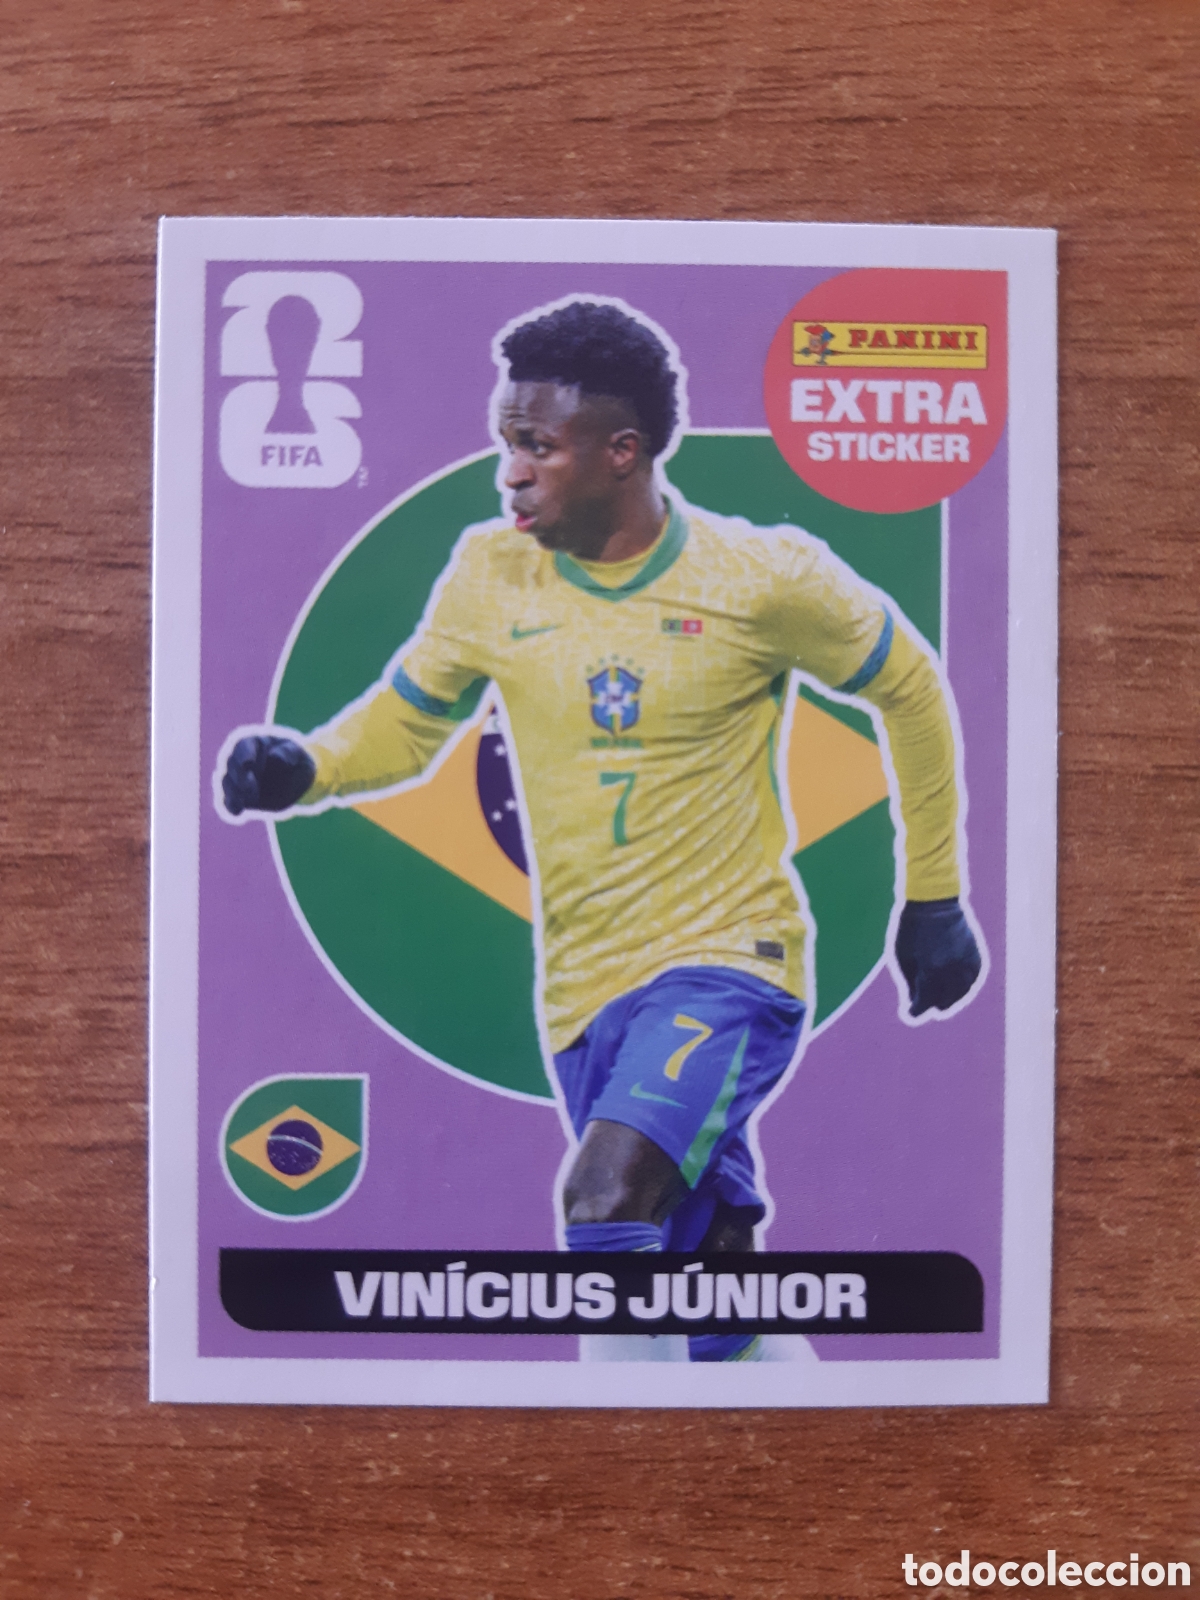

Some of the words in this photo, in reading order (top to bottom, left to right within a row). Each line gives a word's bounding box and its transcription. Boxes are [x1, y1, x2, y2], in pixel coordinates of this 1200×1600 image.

[849, 329, 978, 351] PANINI
[791, 378, 988, 425] EXTRA
[261, 445, 323, 467] FIFA
[807, 431, 971, 463] STICKER
[600, 771, 637, 846] 7
[663, 1013, 714, 1081] 7
[334, 1261, 616, 1319] VINÍCIUS
[628, 1262, 867, 1319] JÚNIOR
